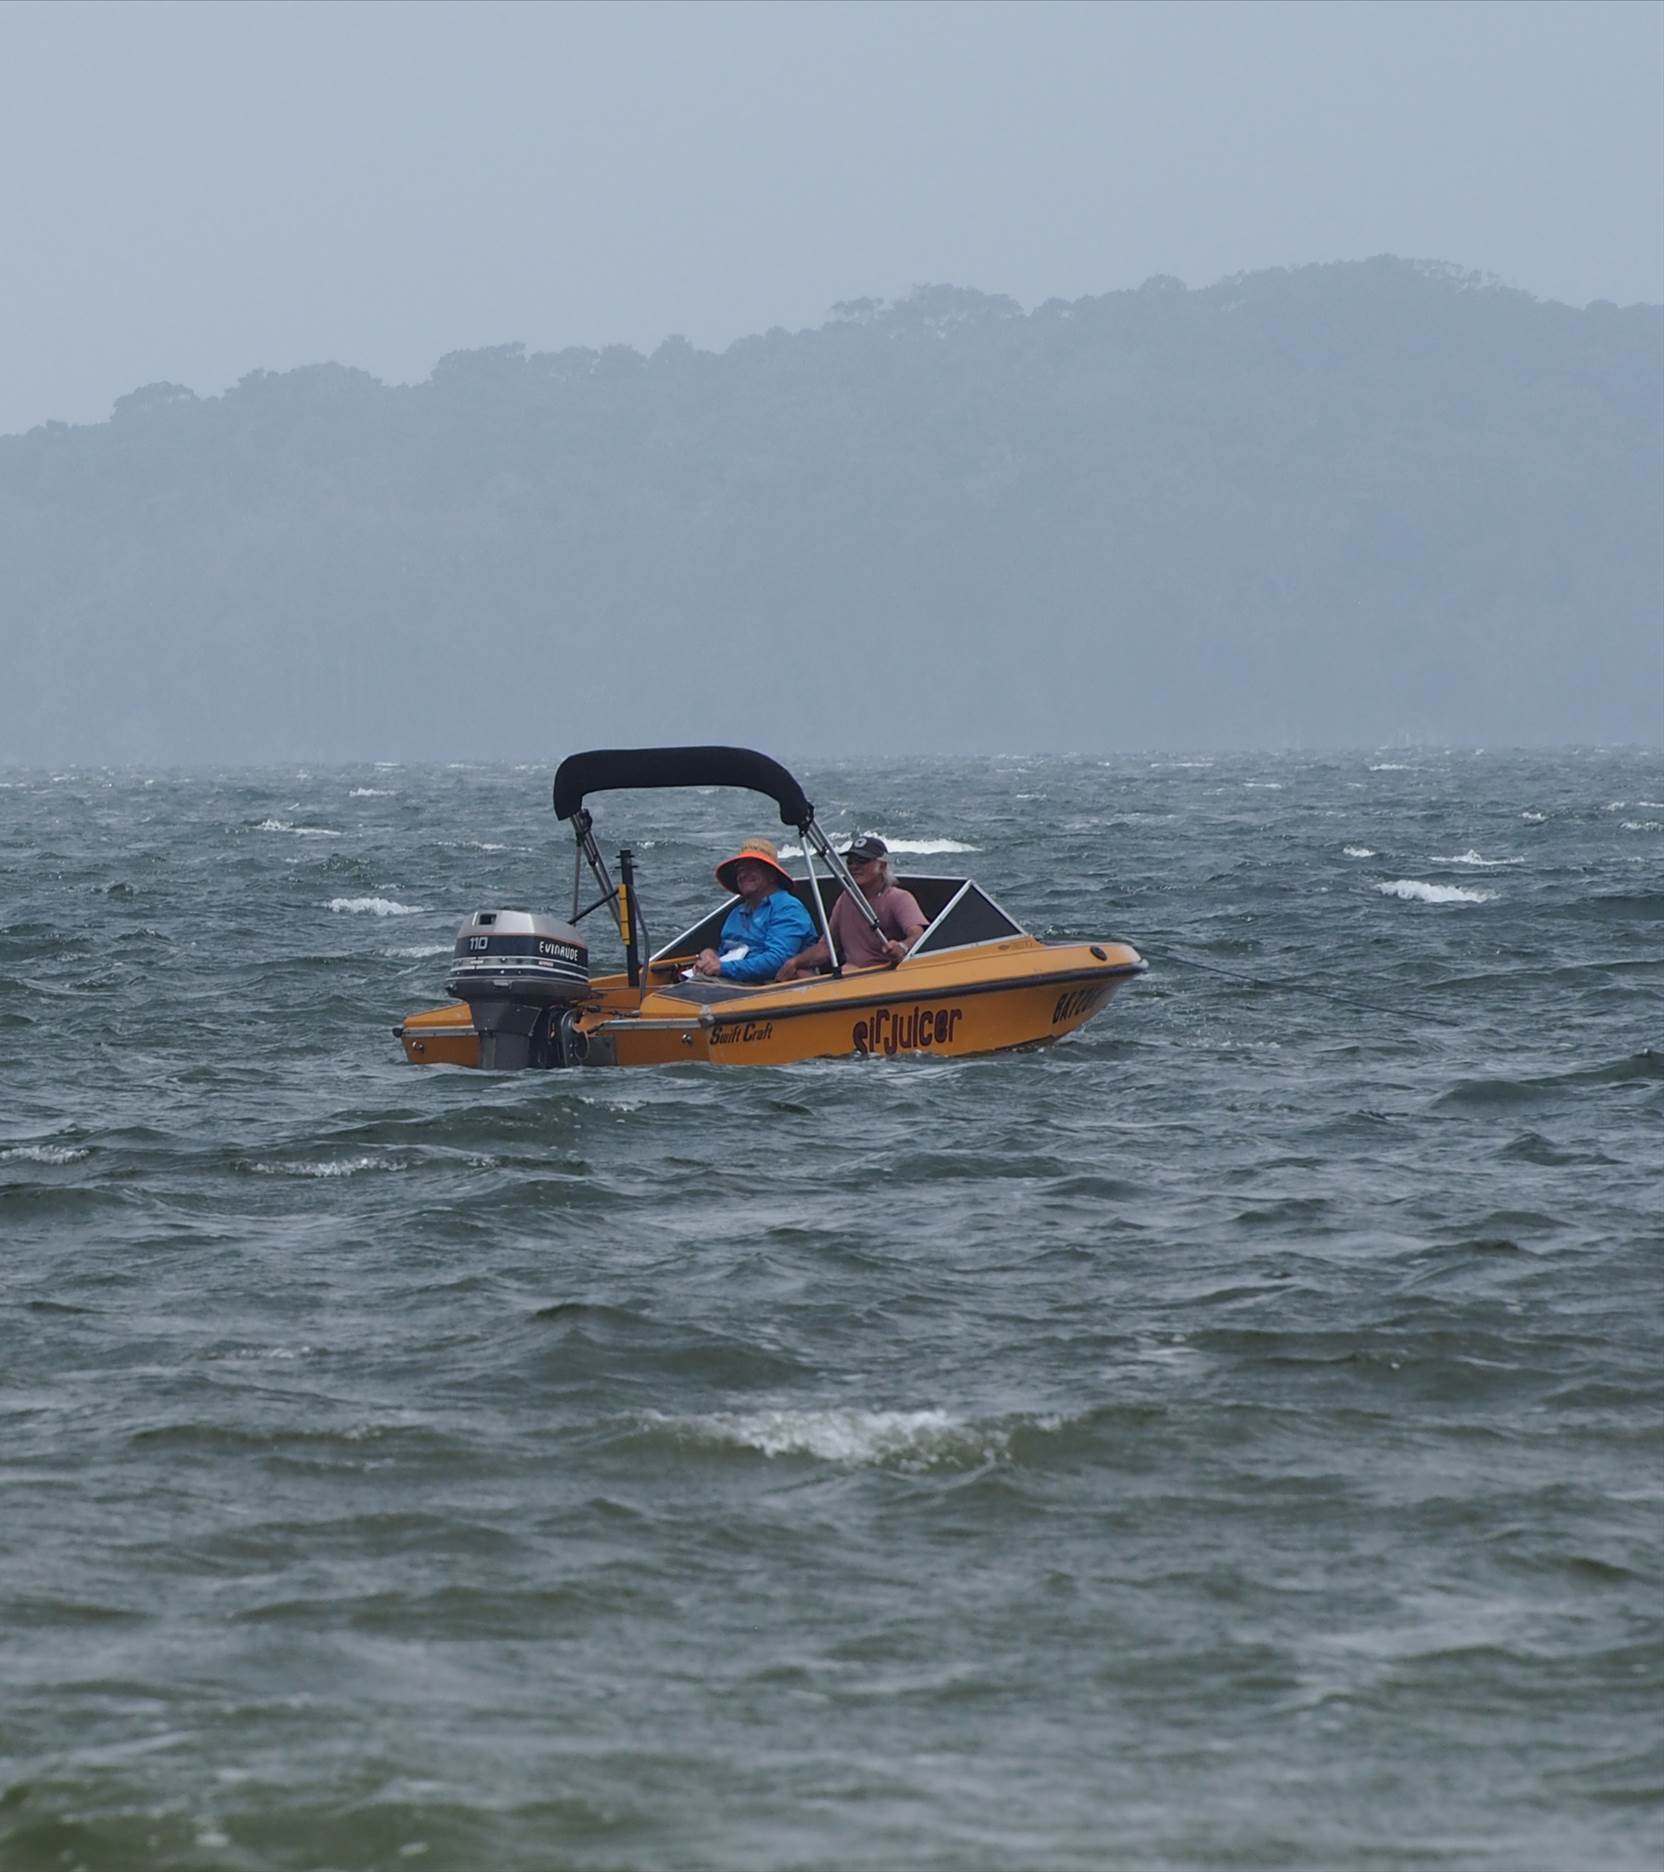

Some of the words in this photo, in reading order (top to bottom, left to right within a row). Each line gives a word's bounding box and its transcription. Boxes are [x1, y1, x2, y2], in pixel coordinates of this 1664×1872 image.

[469, 937, 488, 950] 110
[539, 941, 579, 961] EVINRUDE
[710, 1024, 741, 1045] Swift
[743, 1022, 773, 1042] Craft
